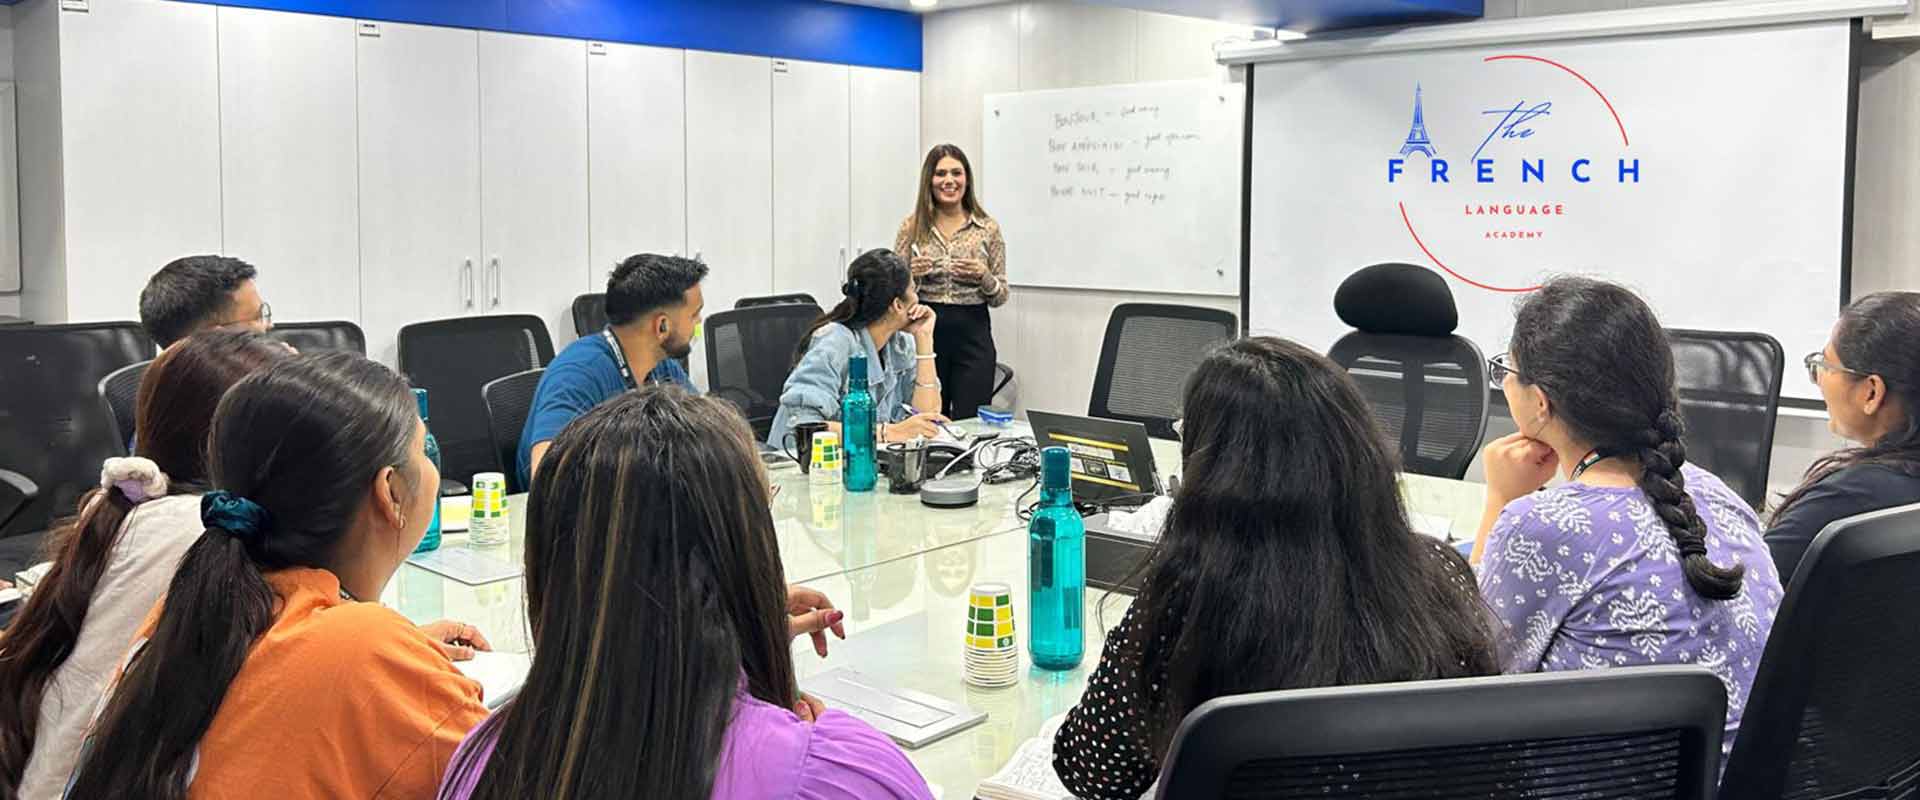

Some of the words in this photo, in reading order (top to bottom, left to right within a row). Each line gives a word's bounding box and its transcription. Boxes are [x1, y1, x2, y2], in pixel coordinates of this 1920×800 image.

[1387, 158, 1640, 184] FRENCH
[1464, 204, 1564, 216] LANGUAGE
[1485, 230, 1543, 239] ACADEMY
